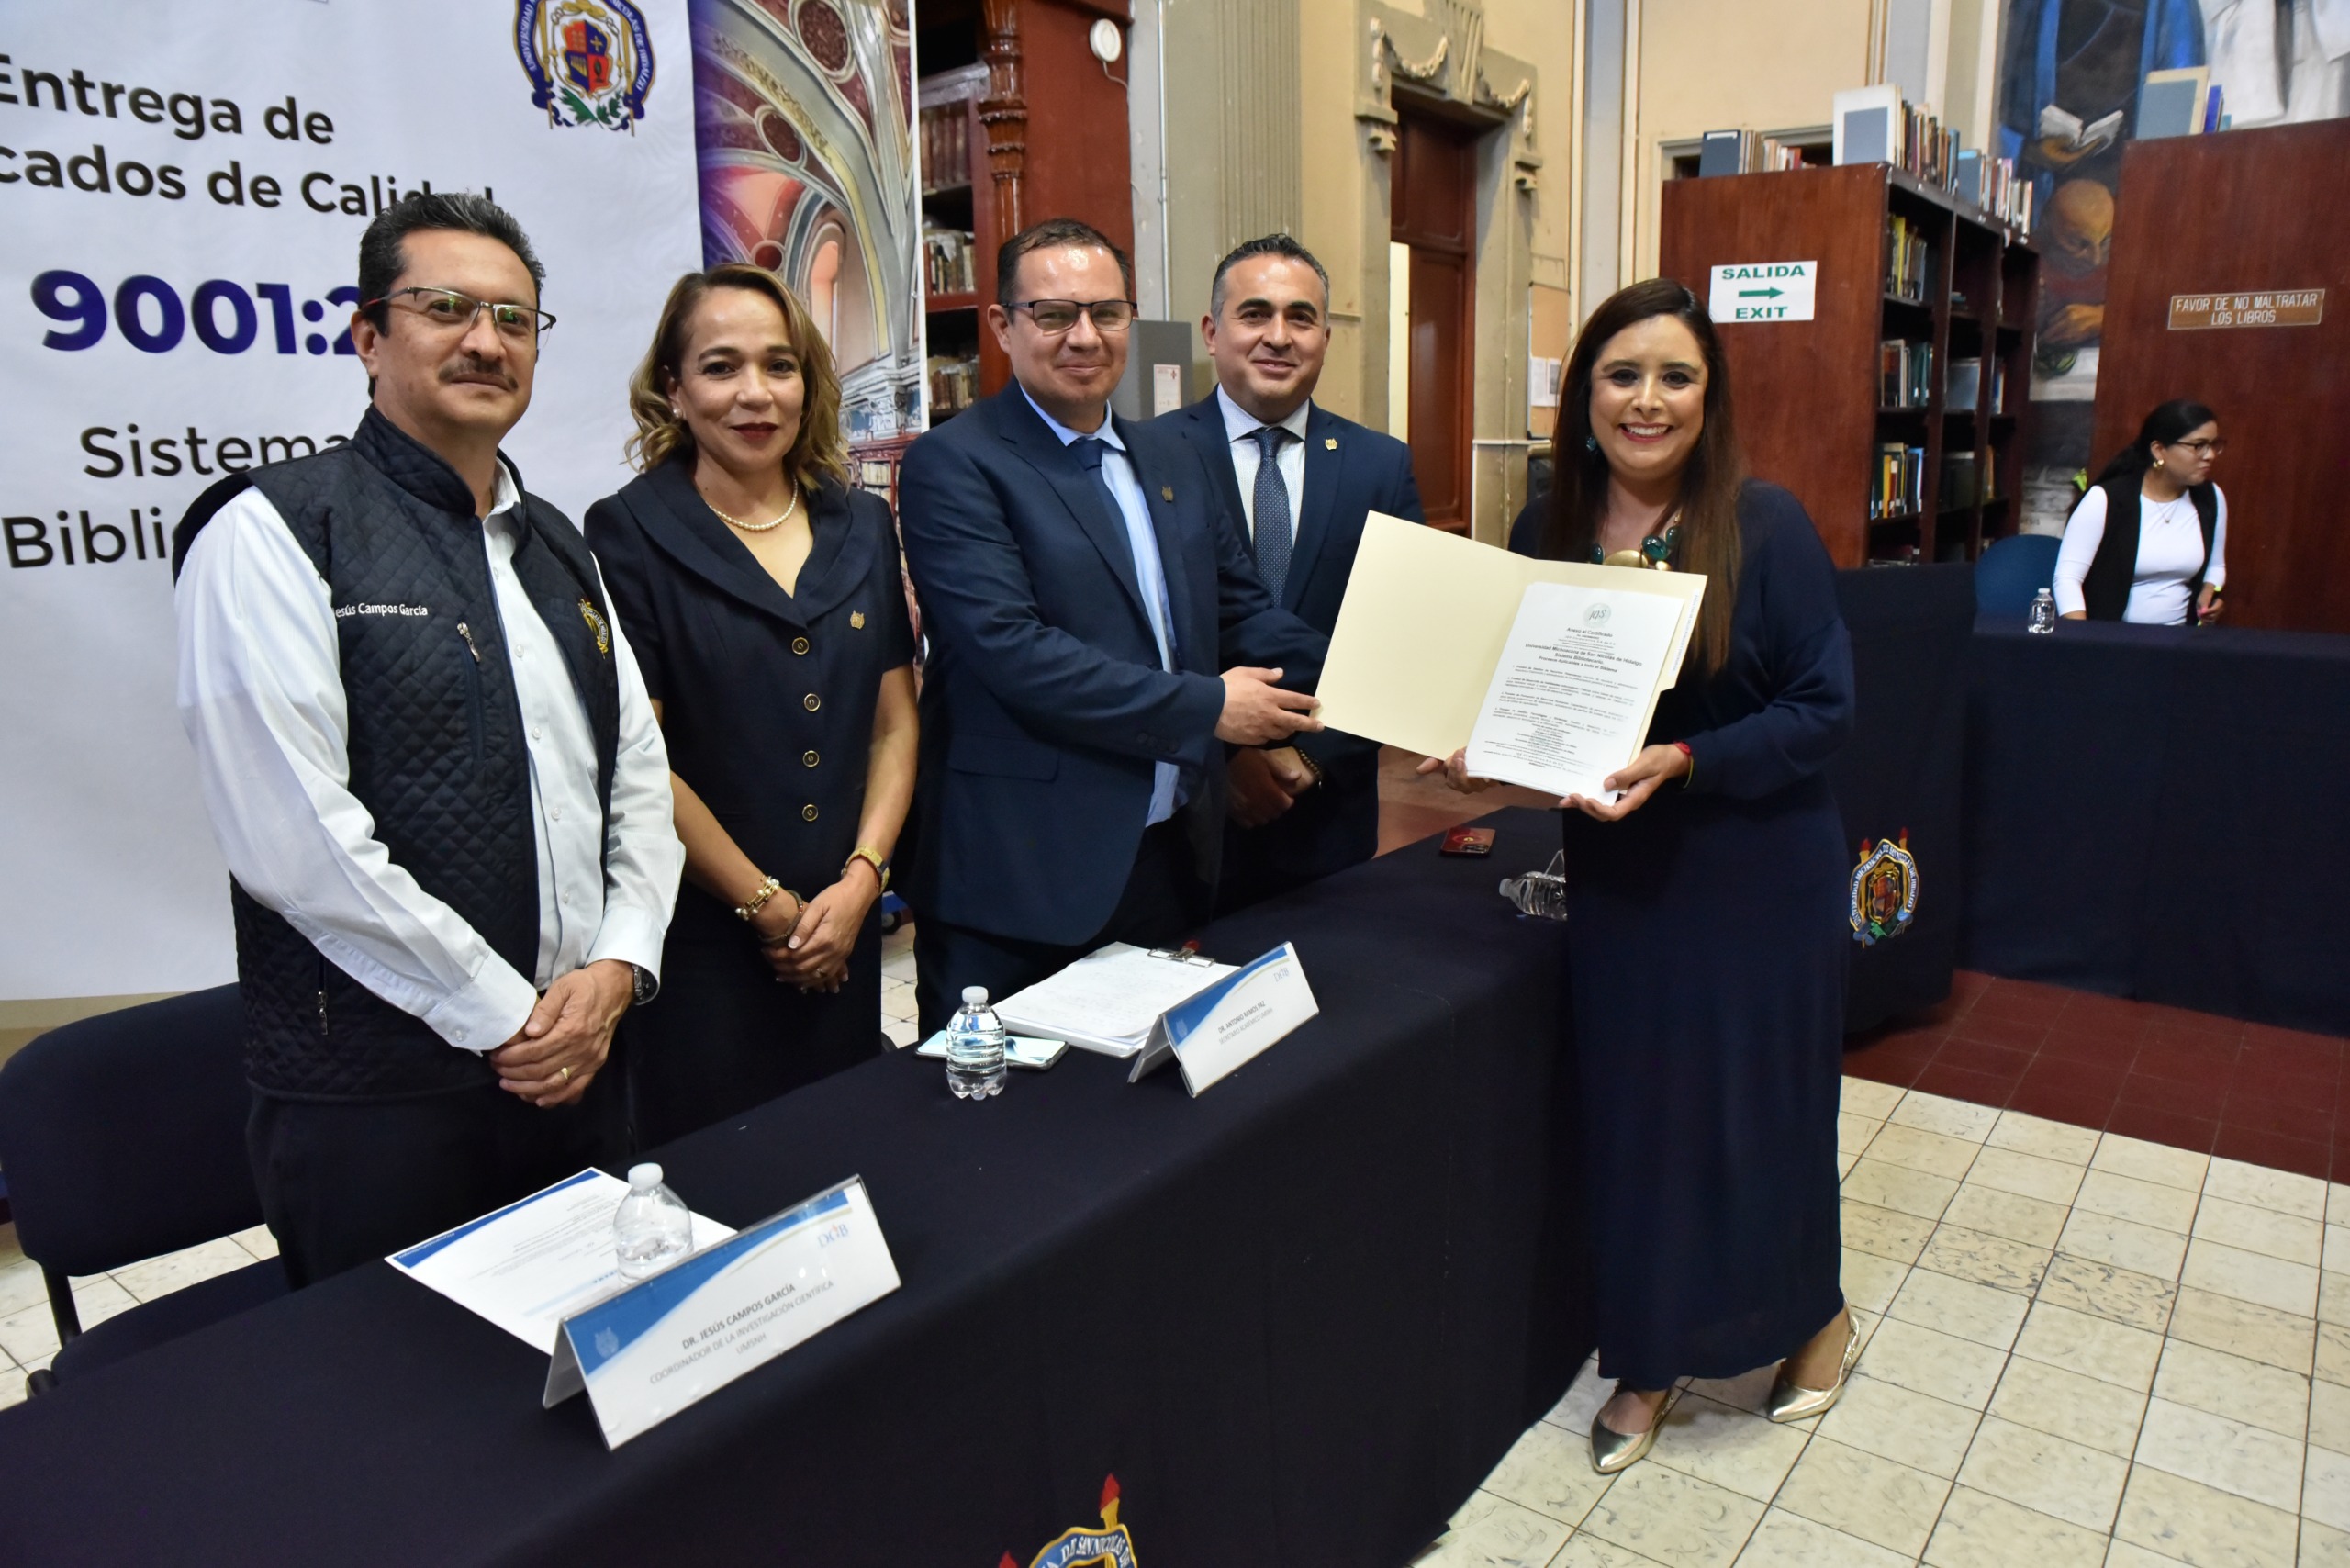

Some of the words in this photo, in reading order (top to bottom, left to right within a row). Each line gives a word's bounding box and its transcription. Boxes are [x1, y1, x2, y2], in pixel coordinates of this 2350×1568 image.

[263, 96, 334, 144] de
[207, 161, 282, 208] de
[1721, 265, 1806, 280] SALIDA
[1735, 307, 1788, 319] EXIT
[2176, 298, 2210, 312] FAVOR
[2214, 297, 2229, 311] DE
[2233, 296, 2249, 310] NO
[2254, 293, 2318, 309] MALTRATAR
[2210, 312, 2232, 325] LOS
[2236, 310, 2277, 325] LIBROS
[1, 506, 179, 568] Bibli
[331, 604, 356, 618] esús
[358, 602, 398, 617] Campos
[1525, 643, 1551, 651] Universidad
[1552, 645, 1579, 655] Michoacana
[1623, 657, 1642, 666] Hidalgo
[1225, 1014, 1244, 1028] ANTONIO
[682, 1336, 699, 1350] DR.
[699, 1319, 725, 1340] JESÚS
[726, 1300, 764, 1326] CAMPOS
[764, 1283, 796, 1305] GARCÍA
[650, 1345, 711, 1384] COORDINADOR
[712, 1338, 723, 1351] DE
[724, 1332, 735, 1344] LA
[735, 1301, 794, 1337] INVESTIGACIÓN
[794, 1280, 834, 1306] CIENTÍFICA
[736, 1333, 767, 1355] UMSNH
